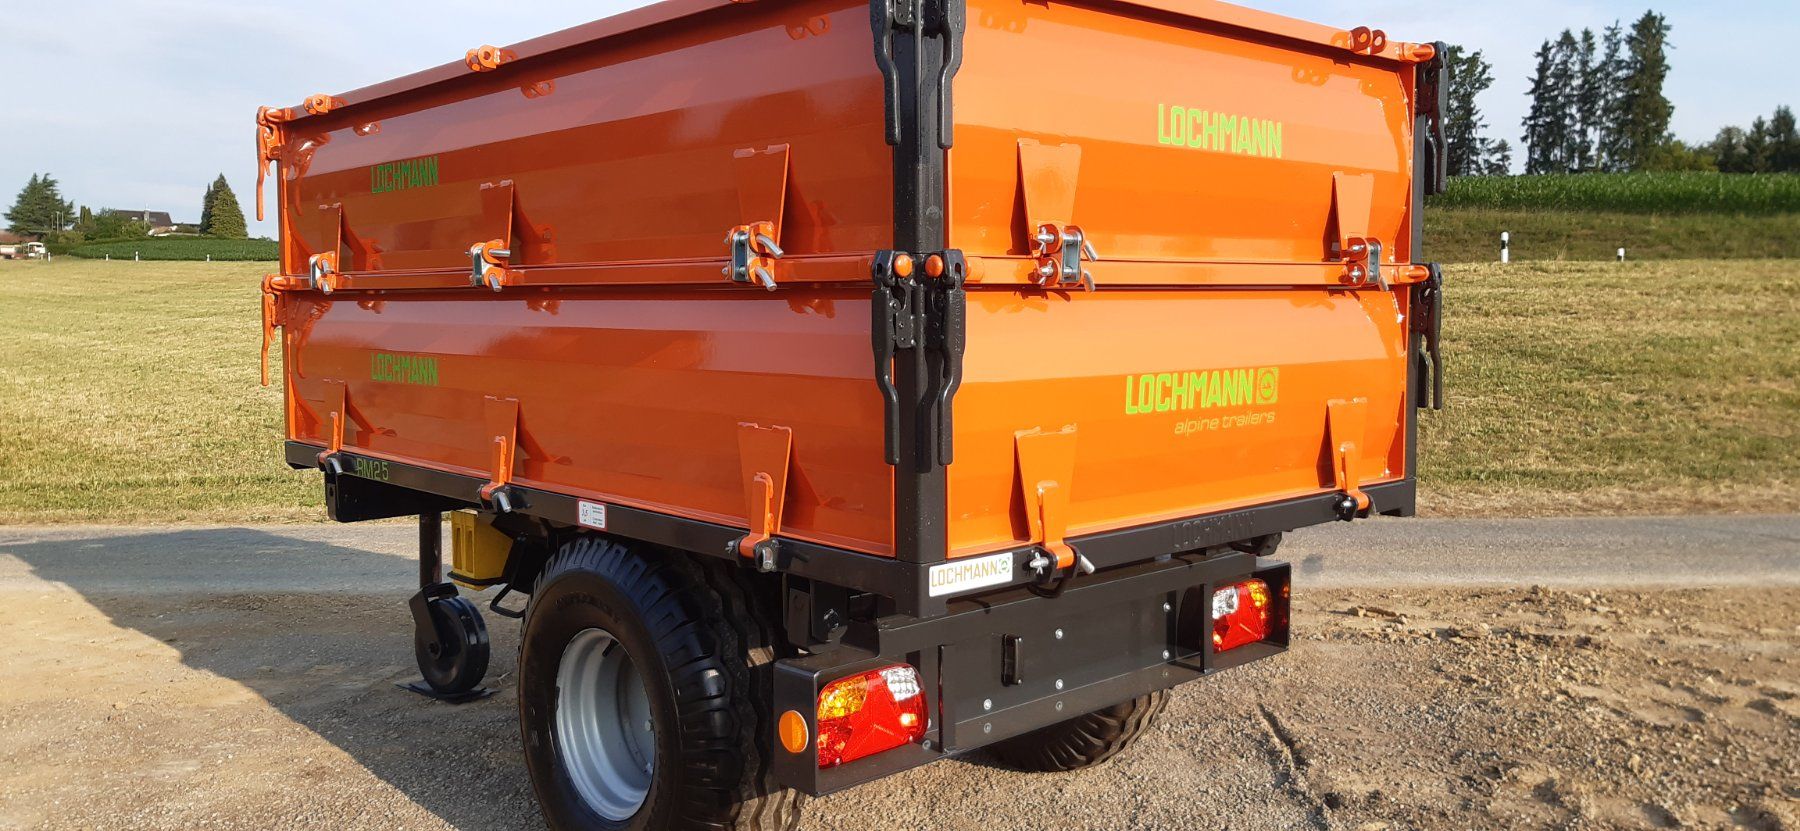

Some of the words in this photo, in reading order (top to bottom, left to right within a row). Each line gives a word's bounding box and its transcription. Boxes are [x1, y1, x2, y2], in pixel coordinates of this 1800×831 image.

[1158, 103, 1282, 159] LOCHMANN
[371, 154, 439, 194] LOCHMANN
[371, 351, 439, 386] LOCHMANN
[1125, 368, 1254, 415] LOCHMANN
[1174, 416, 1220, 436] alpine
[1222, 410, 1276, 429] trailers
[356, 457, 389, 481] RM25
[931, 560, 998, 587] LOCHMANN
